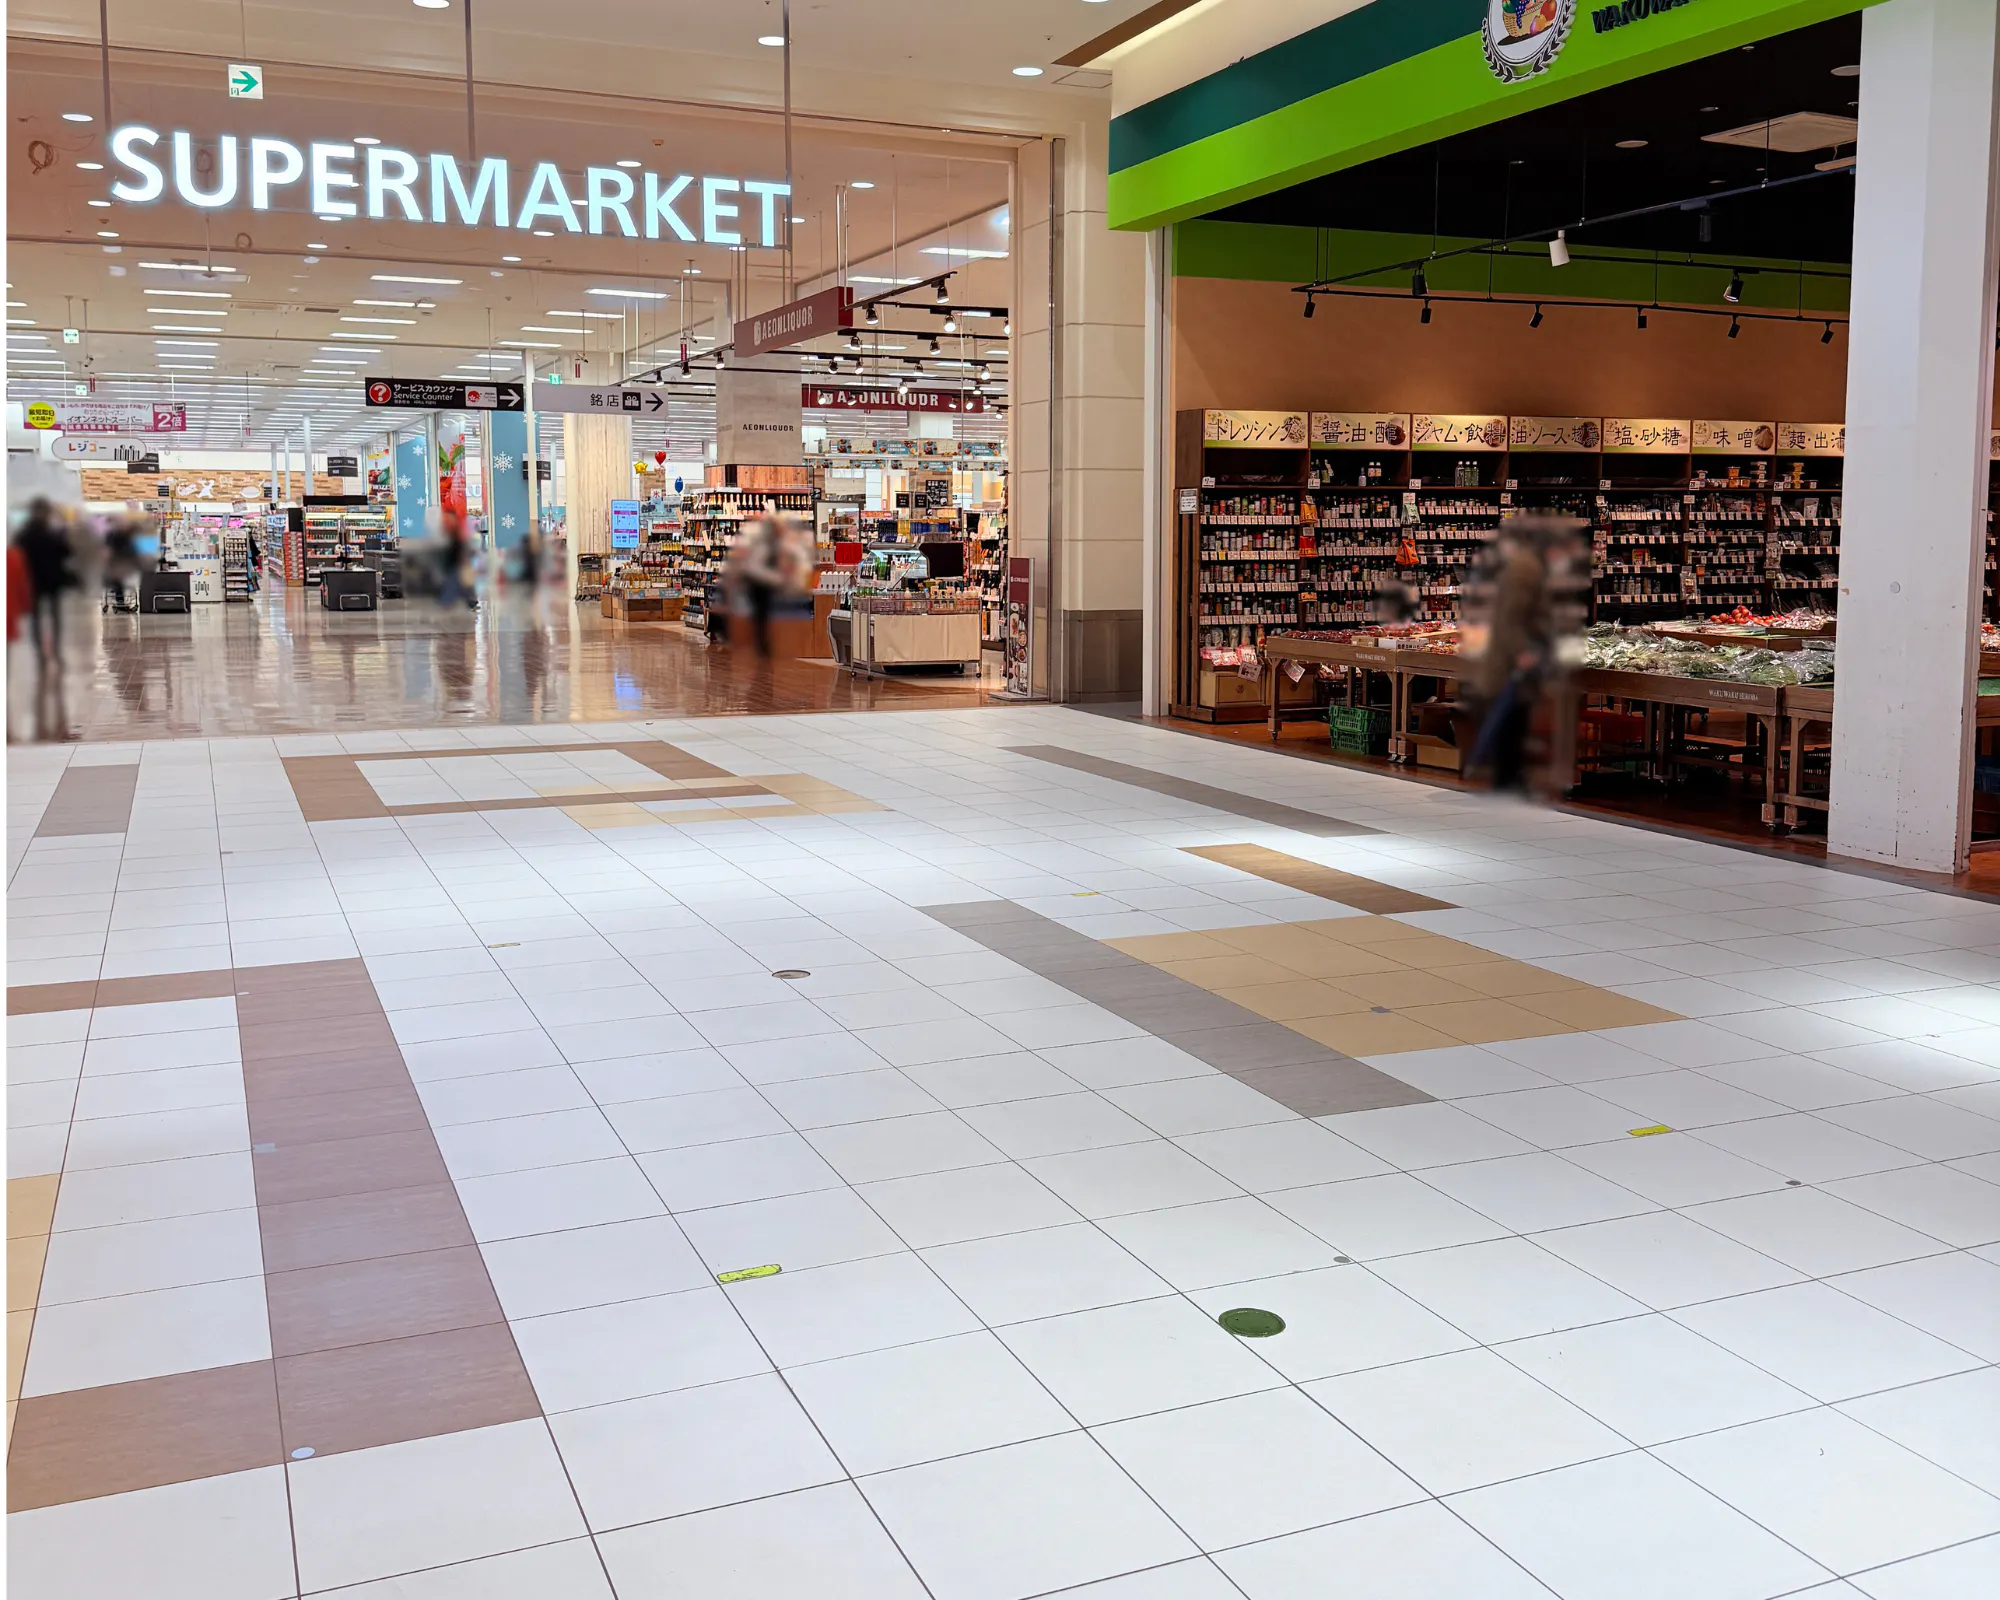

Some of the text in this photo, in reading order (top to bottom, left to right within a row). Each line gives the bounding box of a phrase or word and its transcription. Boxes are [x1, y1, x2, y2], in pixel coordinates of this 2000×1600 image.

[1591, 0, 1698, 34] WAKUWA
[111, 126, 791, 247] SUPERMARKET
[762, 305, 813, 340] AEONLIQUOR
[394, 384, 464, 393] サービスカウンター
[394, 392, 453, 401] Service Counter
[590, 393, 619, 407] 銘店
[837, 391, 939, 406] AONLIQUOR
[67, 415, 143, 424] イオンネットスーパー
[743, 423, 794, 432] AEONLIQUOR
